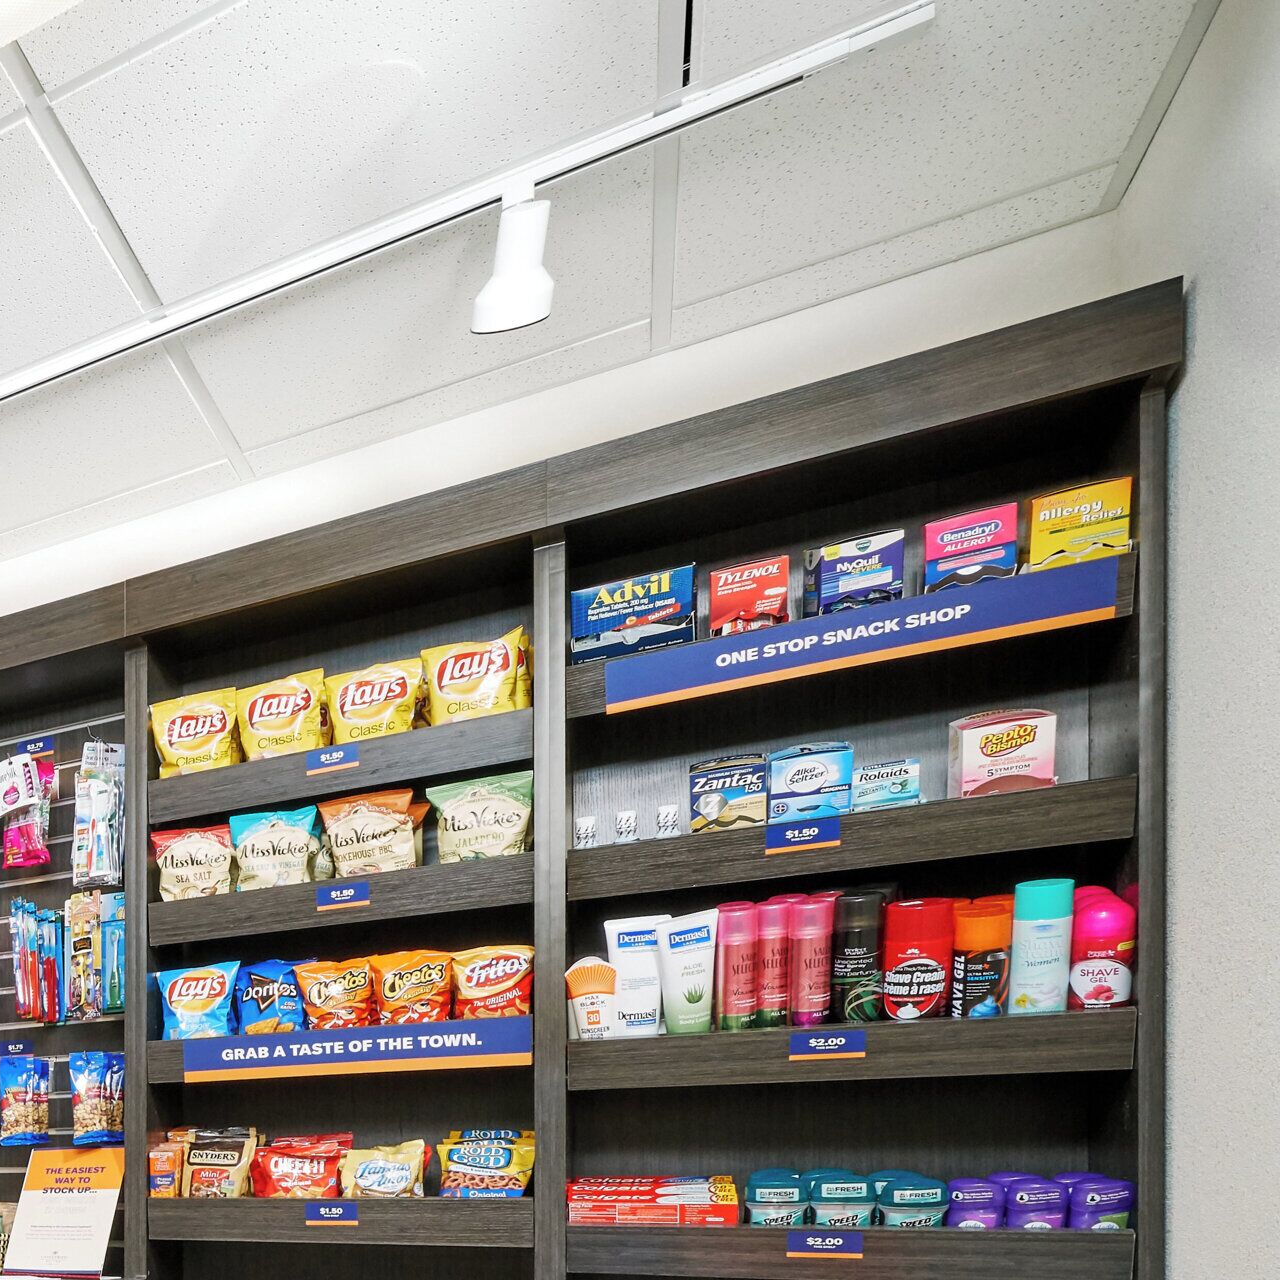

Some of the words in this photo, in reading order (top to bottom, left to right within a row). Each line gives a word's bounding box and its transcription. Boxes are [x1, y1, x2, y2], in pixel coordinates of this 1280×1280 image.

[1040, 500, 1103, 522] Allergy
[1081, 507, 1124, 523] Relief
[942, 523, 996, 542] Benadryl
[943, 535, 994, 552] ALLERGY
[836, 554, 881, 572] NyQuil
[718, 563, 782, 587] TYLENOL
[592, 573, 672, 608] Advil
[716, 647, 758, 667] ONE
[762, 636, 819, 657] STOP
[822, 618, 901, 644] SNACK
[906, 604, 972, 630] SHOP
[446, 695, 500, 715] Classic
[349, 719, 396, 739] Classic
[257, 731, 303, 750] Classic
[980, 724, 1038, 748] Pepto-
[986, 734, 1036, 756] Bismol
[320, 751, 344, 761] $1.50
[793, 766, 820, 777] Alka-
[859, 767, 910, 782] Rolaids
[987, 768, 994, 777] 5
[995, 763, 1031, 773] SYMPTOM
[692, 772, 764, 794] Zantac
[788, 770, 826, 786] Seltzer
[744, 783, 762, 793] 150
[820, 784, 849, 793] ORIGINAL
[785, 827, 819, 839] $1.50
[330, 888, 355, 899] $1.50
[670, 928, 709, 944] Dermasil
[464, 952, 530, 987] Fritos
[1080, 967, 1120, 978] SHAVE
[383, 962, 445, 1000] Cheetos
[243, 982, 297, 1001] Doritos
[588, 1013, 600, 1023] 30
[617, 1009, 657, 1021] Dermasil
[221, 1045, 270, 1062] GRAB
[273, 1044, 286, 1058] A
[289, 1041, 344, 1057] TASTE
[348, 1039, 373, 1054] OF
[376, 1037, 413, 1051] THE
[416, 1033, 482, 1048] TOWN.
[809, 1037, 845, 1046] $2.00
[191, 1151, 236, 1163] SNYDER'S
[452, 1146, 502, 1157] ROLD
[453, 1154, 506, 1167] GOLD
[65, 1166, 106, 1174] EASIEST
[200, 1169, 220, 1179] Mini
[76, 1176, 90, 1184] TO
[76, 1186, 98, 1194] UP...
[572, 1184, 655, 1194] Colgate
[571, 1194, 655, 1202] Colgate
[764, 1213, 793, 1225] SPEED
[828, 1214, 859, 1226] SPEED
[806, 1237, 843, 1245] $2.00
